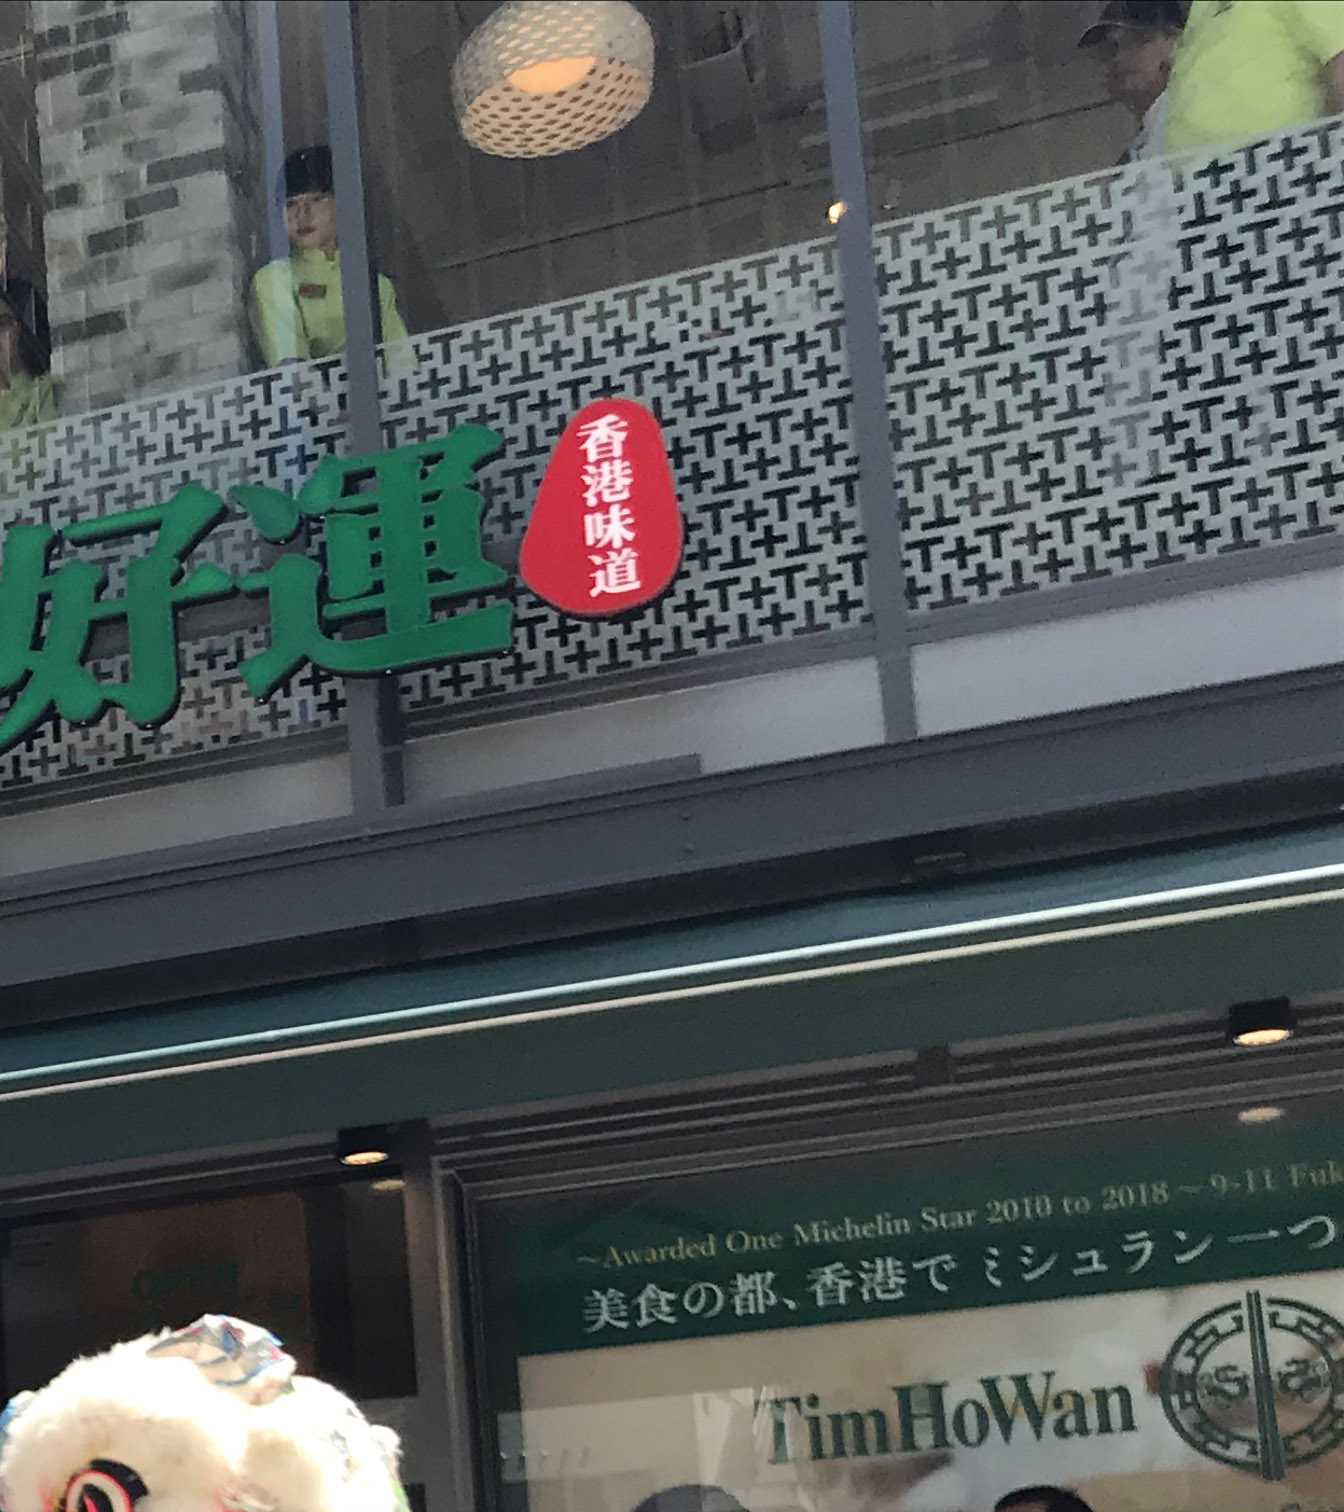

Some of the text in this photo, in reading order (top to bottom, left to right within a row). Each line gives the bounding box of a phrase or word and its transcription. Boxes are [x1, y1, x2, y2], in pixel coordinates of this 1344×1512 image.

[577, 413, 643, 598] 香港味道
[726, 1229, 784, 1253] One
[794, 1212, 911, 1247] Michelin
[920, 1206, 977, 1231] Star
[986, 1194, 1052, 1225] 2010
[1062, 1192, 1090, 1215] to
[1101, 1181, 1170, 1210] 2018
